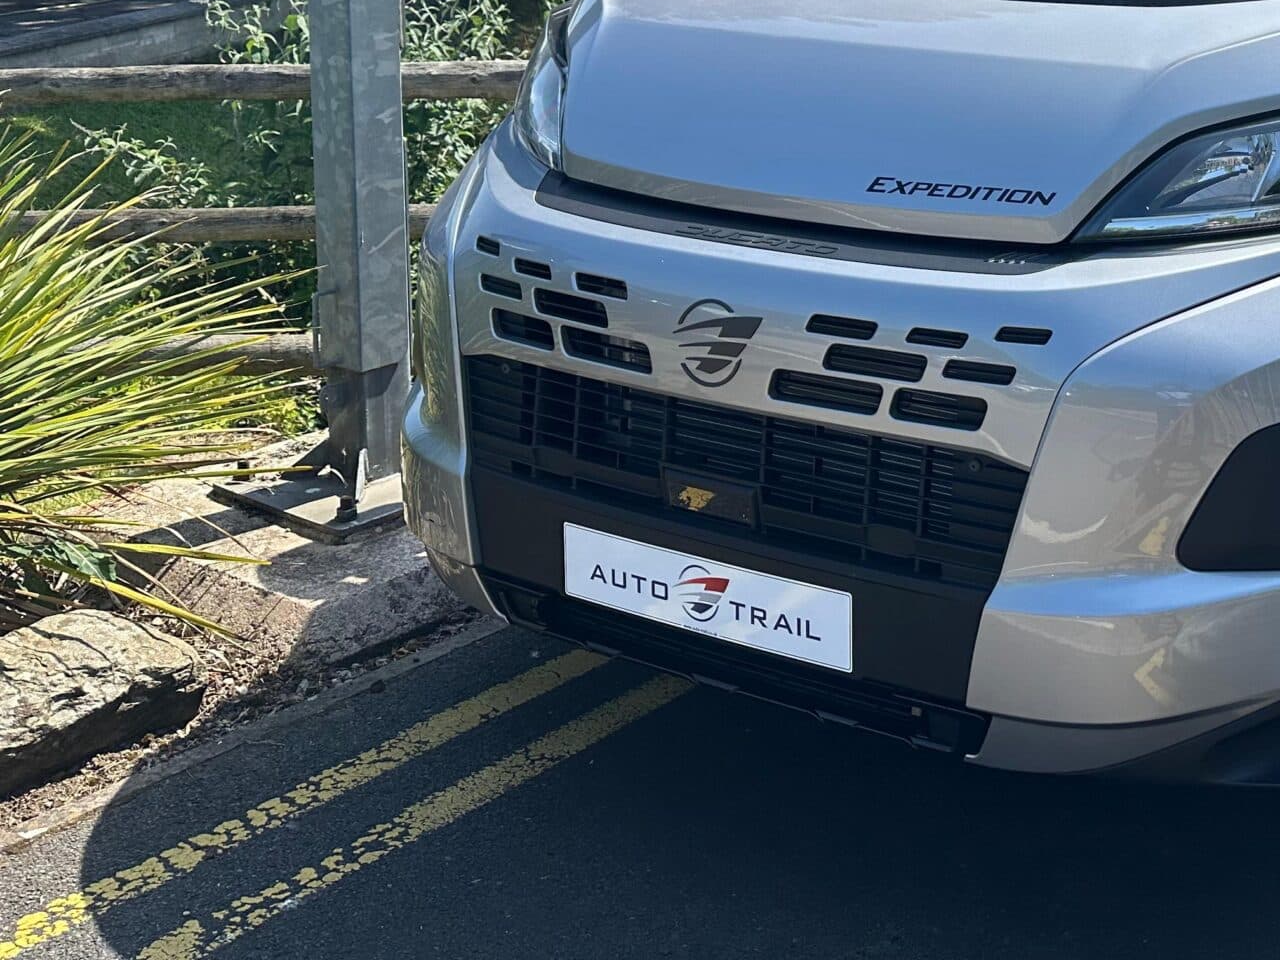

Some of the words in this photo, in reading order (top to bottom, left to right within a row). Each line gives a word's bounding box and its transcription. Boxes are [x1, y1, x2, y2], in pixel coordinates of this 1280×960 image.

[865, 176, 1057, 206] EXPEDITION
[674, 225, 840, 255] DUCATO
[589, 563, 669, 601] AUTO
[728, 600, 822, 642] TRAIL
